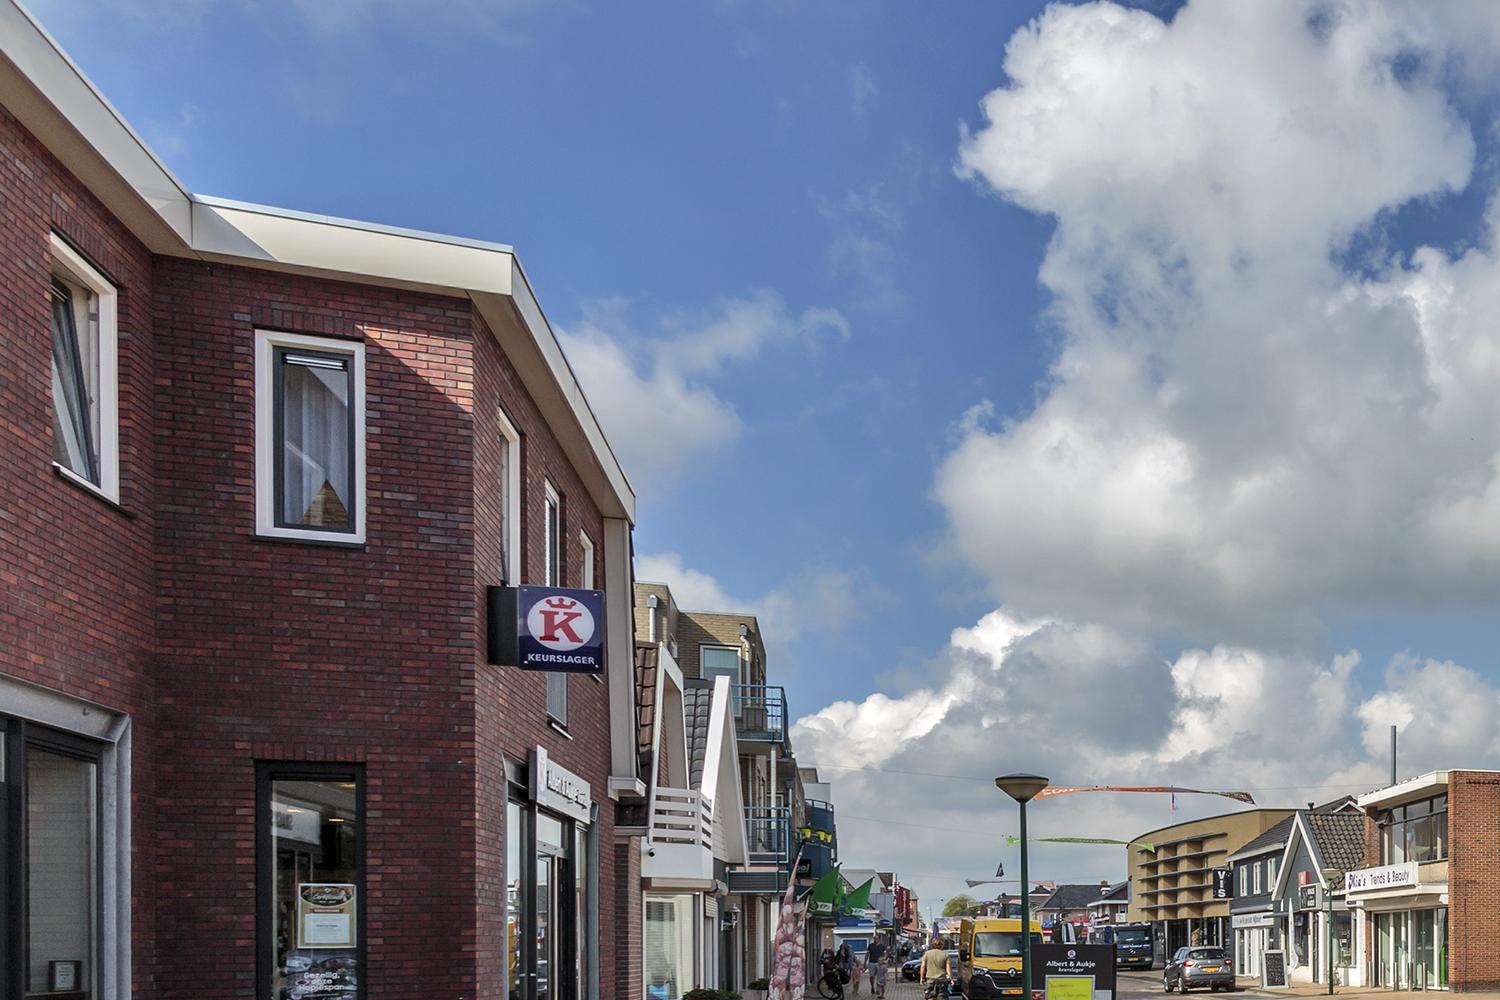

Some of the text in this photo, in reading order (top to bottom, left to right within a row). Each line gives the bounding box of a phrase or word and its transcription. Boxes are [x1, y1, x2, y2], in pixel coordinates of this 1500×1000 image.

[538, 610, 583, 643] K
[527, 653, 595, 665] KEURSLAGER
[1217, 871, 1226, 898] VIS
[1370, 874, 1386, 885] Trends
[1392, 870, 1410, 884] Beauty
[1076, 960, 1096, 968] Aukje
